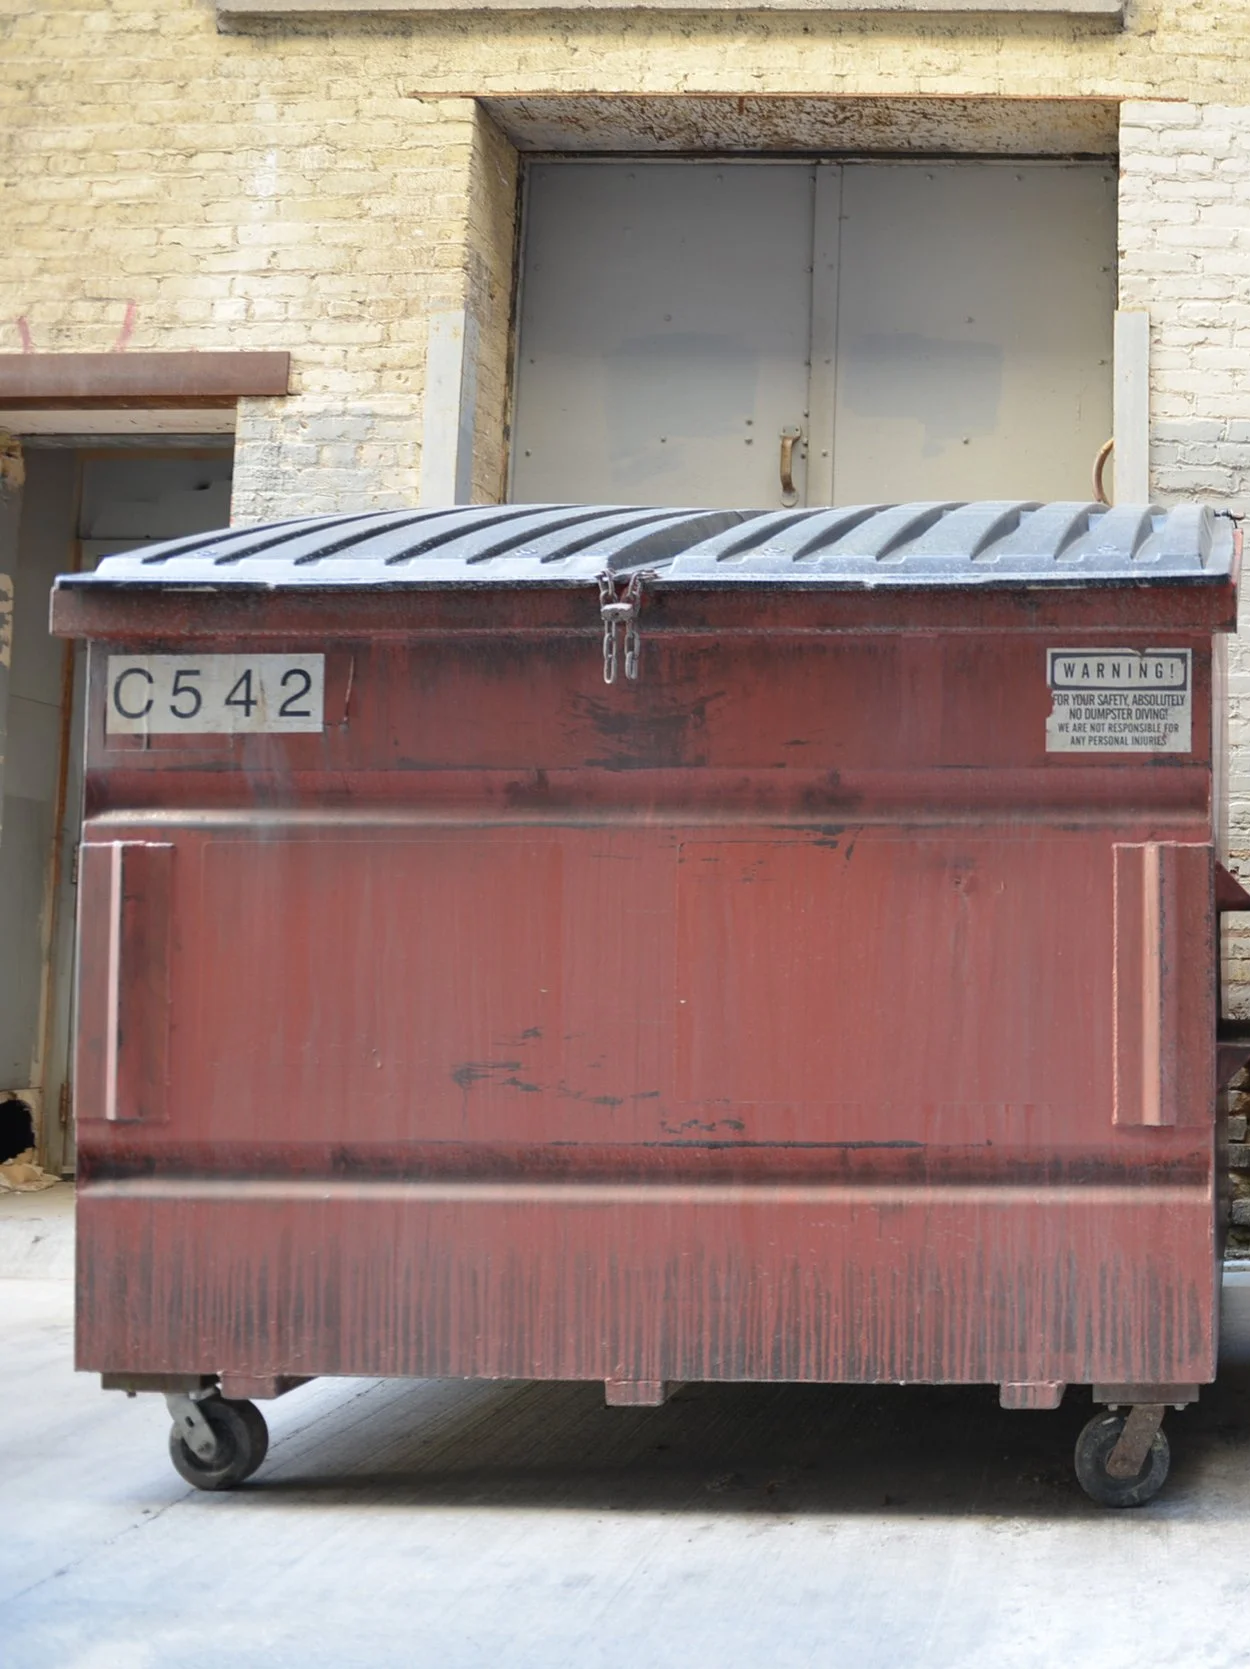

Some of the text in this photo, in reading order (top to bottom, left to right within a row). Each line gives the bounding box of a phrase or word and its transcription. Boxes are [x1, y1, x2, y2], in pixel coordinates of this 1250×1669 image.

[1064, 663, 1174, 679] WARNING!
[113, 668, 312, 718] C542
[1054, 694, 1069, 706] FOR
[1072, 694, 1095, 706] YOUR
[1132, 694, 1185, 706] ABSOLUTELY
[1069, 708, 1169, 720] NO DUMPSTER DIVING!
[1058, 724, 1179, 732] WE ARE NOT RESPONSIBLE FOR
[1071, 736, 1085, 745] ANY
[1088, 736, 1128, 745] PERSONAL
